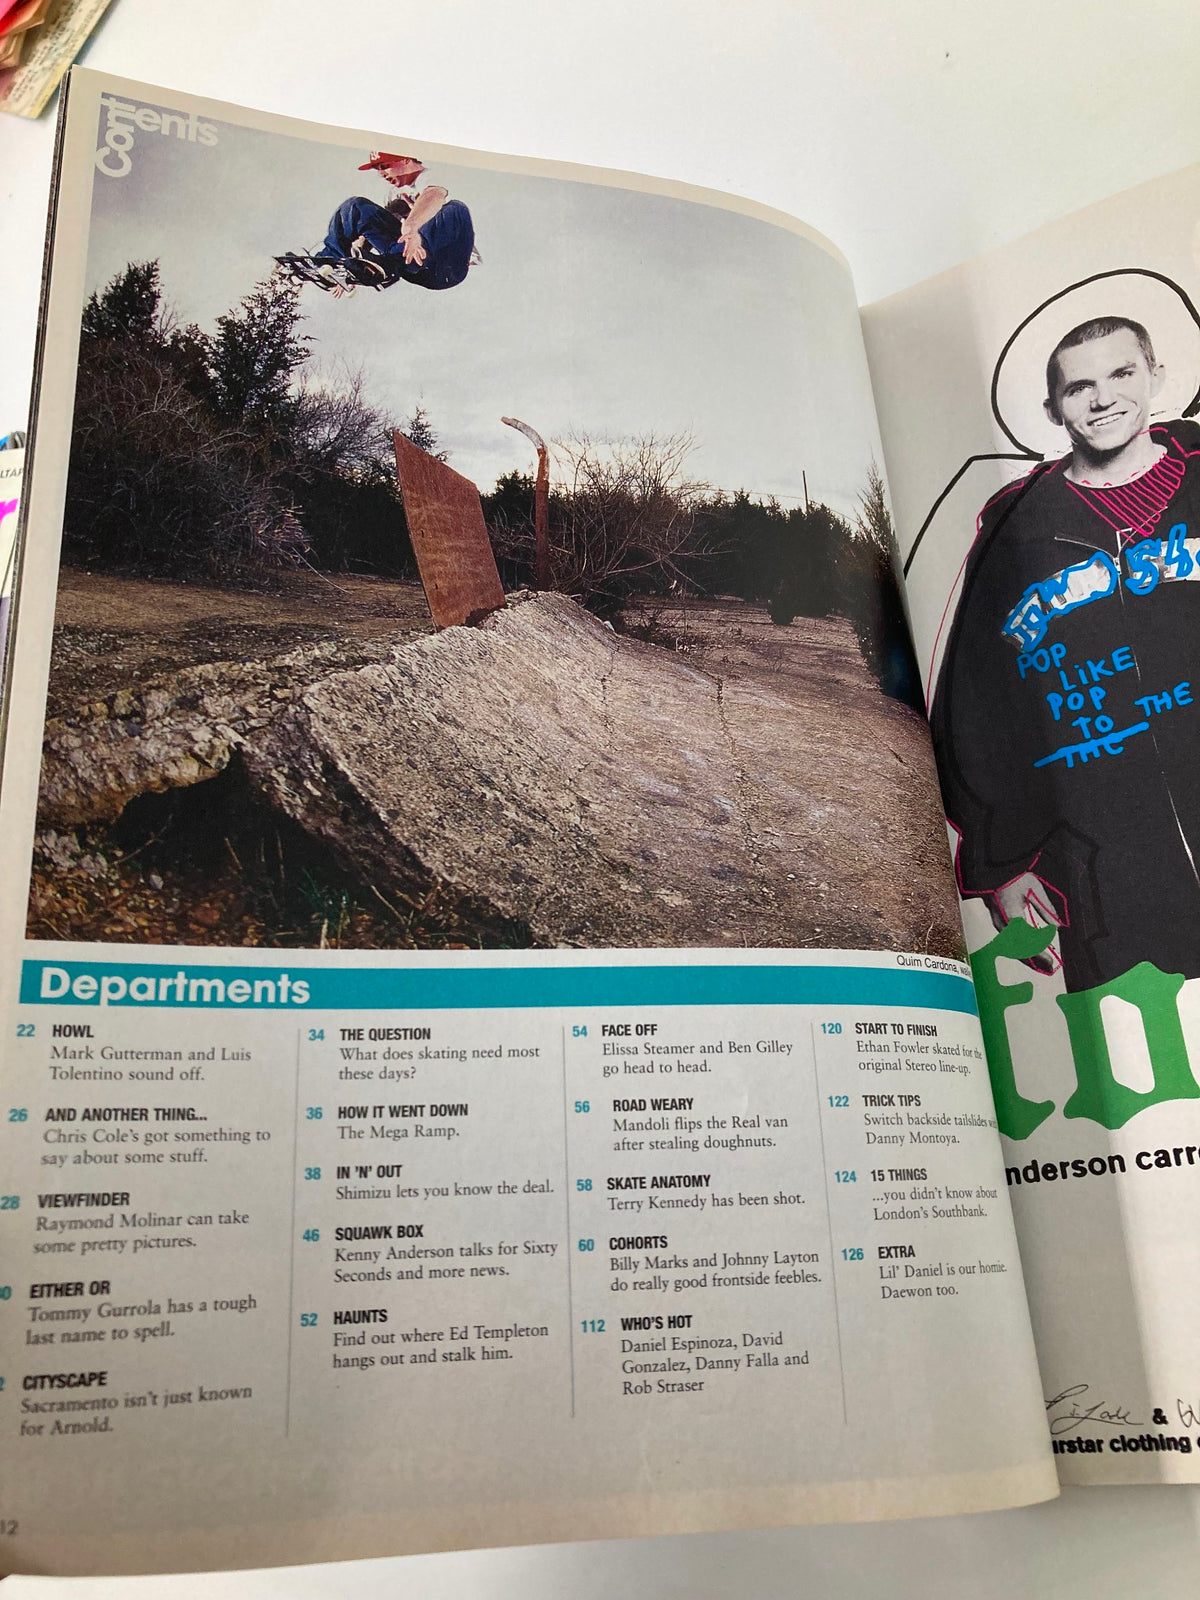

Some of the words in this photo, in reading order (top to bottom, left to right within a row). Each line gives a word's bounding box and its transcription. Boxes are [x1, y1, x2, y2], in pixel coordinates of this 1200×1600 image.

[1016, 643, 1066, 680] POP
[1046, 686, 1106, 720] POP
[1134, 682, 1194, 716] THE
[1072, 715, 1114, 739] TO
[896, 955, 922, 968] Quim
[924, 957, 959, 974] Cardona,
[40, 966, 310, 1006] Departments
[16, 1024, 36, 1037] 22
[52, 1024, 94, 1038] HOWL
[309, 1029, 325, 1041] 34
[340, 1029, 364, 1041] THE
[369, 1028, 431, 1041] QUESTION
[572, 1026, 587, 1037] 54
[602, 1025, 632, 1037] FACE
[635, 1024, 658, 1035] OFF
[821, 1023, 842, 1034] 120
[855, 1023, 888, 1036] START
[891, 1024, 904, 1035] TO
[907, 1024, 937, 1037] FINISH
[51, 1046, 94, 1060] Mark
[100, 1047, 182, 1061] Gutterman
[188, 1048, 215, 1061] and
[222, 1048, 251, 1062] Luis
[340, 1048, 377, 1060] What
[382, 1048, 413, 1060] does
[418, 1046, 467, 1061] skating
[472, 1046, 502, 1058] need
[508, 1047, 540, 1058] most
[602, 1043, 639, 1055] Elissa
[644, 1042, 695, 1055] Steamer
[700, 1041, 723, 1054] and
[728, 1041, 751, 1053] Ben
[756, 1040, 793, 1055] Gilley
[857, 1041, 889, 1053] Ethan
[894, 1041, 929, 1054] Fowler
[933, 1044, 960, 1056] skated
[962, 1046, 972, 1057] for
[50, 1066, 122, 1080] Tolentino
[129, 1067, 174, 1080] sound
[180, 1067, 205, 1081] off.
[602, 1062, 619, 1077] go
[624, 1062, 655, 1074] head
[659, 1062, 672, 1073] to
[677, 1060, 712, 1073] head.
[859, 1059, 902, 1072] original
[905, 1059, 937, 1072] Stereo
[939, 1061, 971, 1076] line-up.
[575, 1102, 590, 1113] 56
[613, 1100, 647, 1112] ROAD
[651, 1098, 694, 1110] WEARY
[828, 1096, 849, 1107] 122
[862, 1095, 895, 1107] TRICK
[899, 1095, 921, 1107] TIPS
[8, 1108, 28, 1122] 26
[45, 1108, 76, 1122] AND
[82, 1108, 148, 1121] ANOTHER
[153, 1108, 208, 1121] THING...
[306, 1108, 322, 1119] 36
[338, 1106, 369, 1119] HOW
[373, 1106, 384, 1118] IT
[389, 1105, 426, 1118] WENT
[430, 1104, 468, 1116] DOWN
[613, 1118, 669, 1132] Mandoli
[674, 1117, 702, 1131] flips
[707, 1116, 727, 1129] the
[731, 1115, 760, 1128] Real
[765, 1117, 788, 1127] van
[864, 1113, 903, 1126] Switch
[908, 1114, 951, 1127] backside
[954, 1116, 988, 1128] tailslides
[44, 1129, 86, 1144] Chris
[93, 1128, 139, 1143] Cole's
[144, 1130, 168, 1145] got
[174, 1128, 250, 1144] something
[256, 1130, 270, 1141] to
[338, 1126, 364, 1139] The
[370, 1125, 409, 1140] Mega
[414, 1124, 460, 1139] Ramp.
[866, 1132, 904, 1146] Danny
[909, 1132, 960, 1146] Montoya.
[304, 1168, 321, 1180] 38
[337, 1166, 350, 1179] IN
[377, 1165, 402, 1178] OUT
[835, 1171, 856, 1182] 124
[871, 1170, 884, 1181] 15
[888, 1169, 927, 1181] THINGS
[1005, 1155, 1126, 1186] nderson
[336, 1186, 391, 1200] Shimizu
[396, 1186, 419, 1198] lets
[424, 1186, 449, 1200] you
[454, 1183, 492, 1196] know
[497, 1181, 518, 1194] the
[522, 1179, 554, 1193] deal.
[577, 1179, 592, 1191] 58
[607, 1177, 646, 1190] SKATE
[651, 1175, 710, 1188] ANATOMY
[0, 1196, 20, 1210] 28
[38, 1192, 130, 1208] VIEWFINDER
[607, 1198, 644, 1211] Terry
[648, 1196, 706, 1211] Kennedy
[711, 1194, 734, 1207] has
[738, 1194, 768, 1206] been
[772, 1192, 805, 1205] shot.
[872, 1191, 905, 1203] ...you
[910, 1188, 941, 1200] didn't
[946, 1187, 972, 1199] know
[976, 1186, 997, 1199] about
[874, 1208, 928, 1221] London's
[932, 1205, 987, 1218] Southbank.
[302, 1229, 319, 1242] 46
[335, 1226, 392, 1241] SQUAWK
[397, 1225, 423, 1239] BOX
[578, 1240, 594, 1251] 60
[609, 1236, 667, 1250] COHORTS
[610, 1257, 639, 1272] Billy
[644, 1255, 688, 1269] Marks
[693, 1255, 717, 1267] and
[721, 1253, 769, 1269] Johnny
[773, 1251, 819, 1266] Layton
[842, 1249, 863, 1260] 126
[878, 1246, 915, 1259] EXTRA
[880, 1265, 899, 1279] Lil'
[904, 1263, 943, 1278] Daniel
[947, 1264, 956, 1276] is
[959, 1264, 976, 1274] our
[979, 1262, 1007, 1274] homie.
[30, 1282, 84, 1299] EITHER
[90, 1281, 110, 1296] OR
[300, 1314, 318, 1326] 52
[333, 1309, 388, 1324] HAUNTS
[581, 1320, 605, 1333] 112
[621, 1316, 663, 1330] WHO'S
[667, 1315, 692, 1328] HOT
[333, 1332, 365, 1346] Find
[371, 1332, 395, 1344] out
[401, 1328, 444, 1343] where
[450, 1327, 468, 1340] Ed
[474, 1324, 549, 1341] Templeton
[622, 1338, 666, 1353] Daniel
[672, 1335, 737, 1352] Espinoza,
[742, 1332, 783, 1346] David
[22, 1372, 108, 1390] CITYSCAPE
[1152, 1408, 1168, 1425] &
[1109, 1433, 1192, 1454] clothing
[0, 1520, 18, 1535] 12
